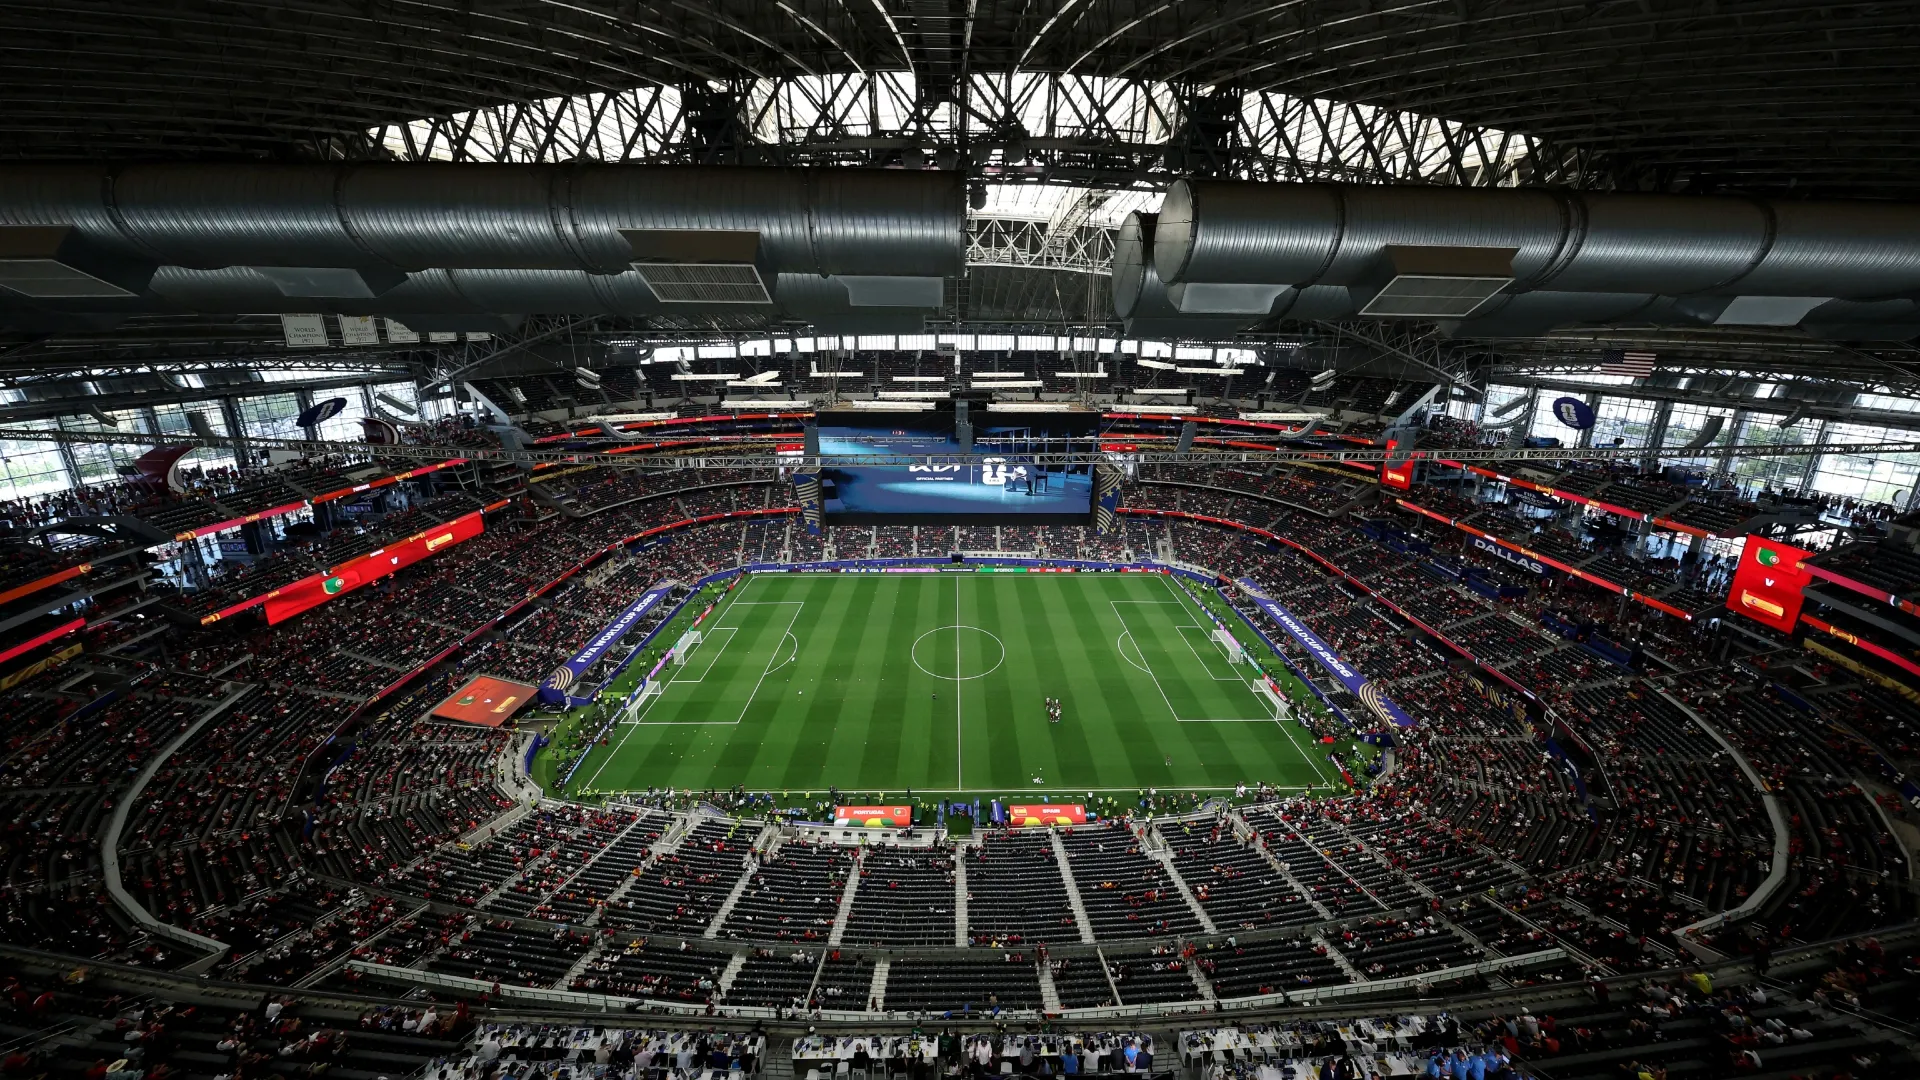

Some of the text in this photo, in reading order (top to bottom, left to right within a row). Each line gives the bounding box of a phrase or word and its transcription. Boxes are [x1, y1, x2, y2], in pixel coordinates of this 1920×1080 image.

[1474, 538, 1543, 574] DALLAS
[576, 593, 658, 663] FIFA WORLD CUP 2026
[1266, 603, 1354, 678] FIFA WORLD CUP 2026
